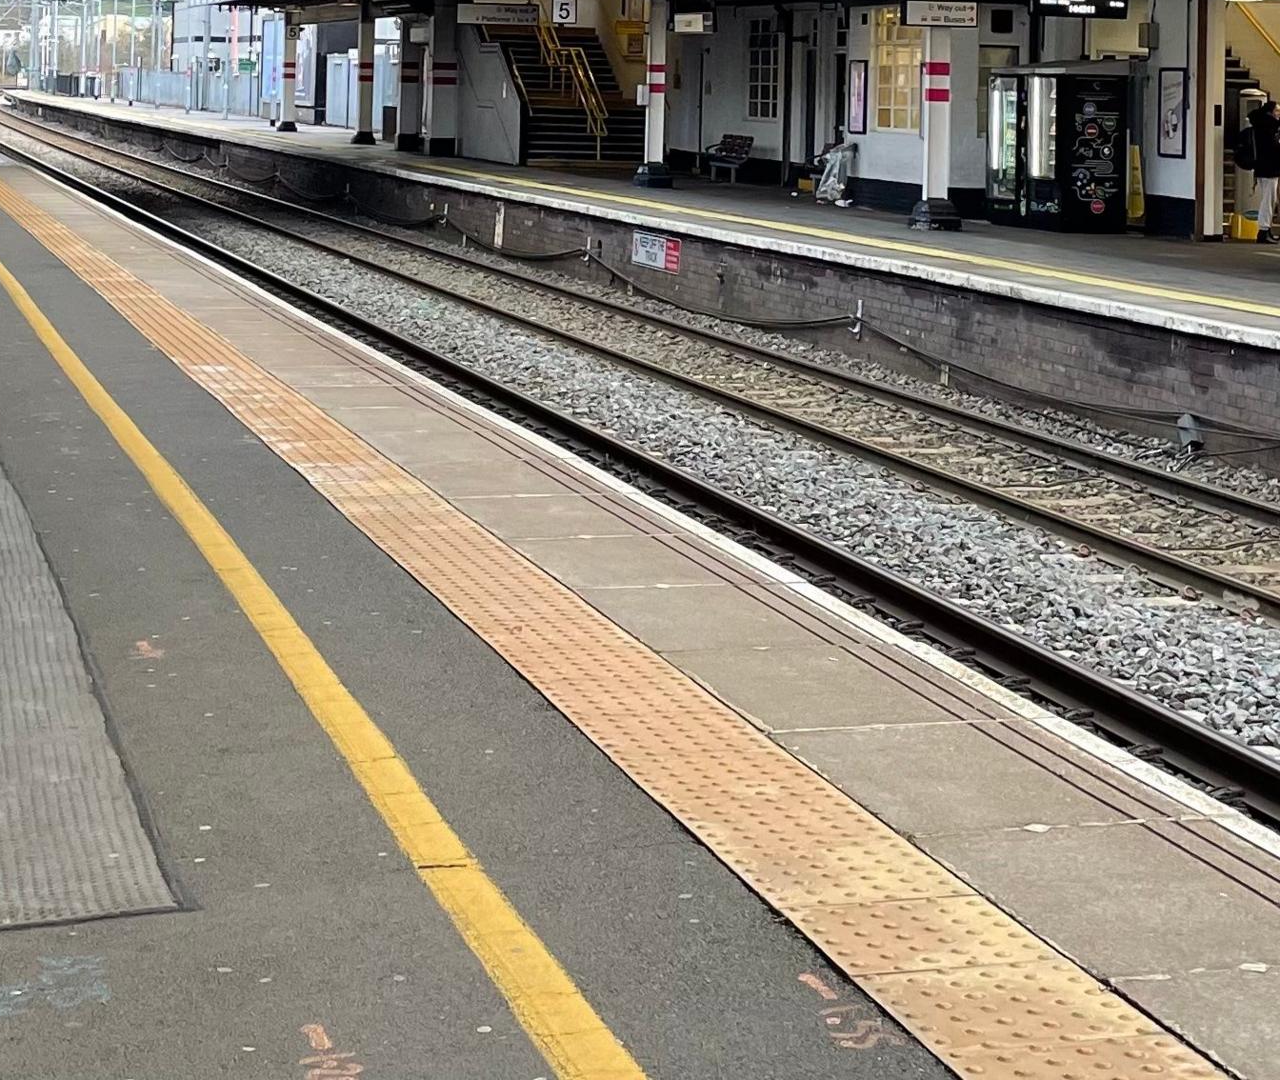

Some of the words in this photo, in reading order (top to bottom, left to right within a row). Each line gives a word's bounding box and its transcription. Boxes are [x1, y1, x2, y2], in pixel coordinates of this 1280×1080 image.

[558, 2, 571, 20] 5
[937, 4, 953, 13] Way
[943, 15, 967, 24] Buses
[289, 27, 297, 38] 5
